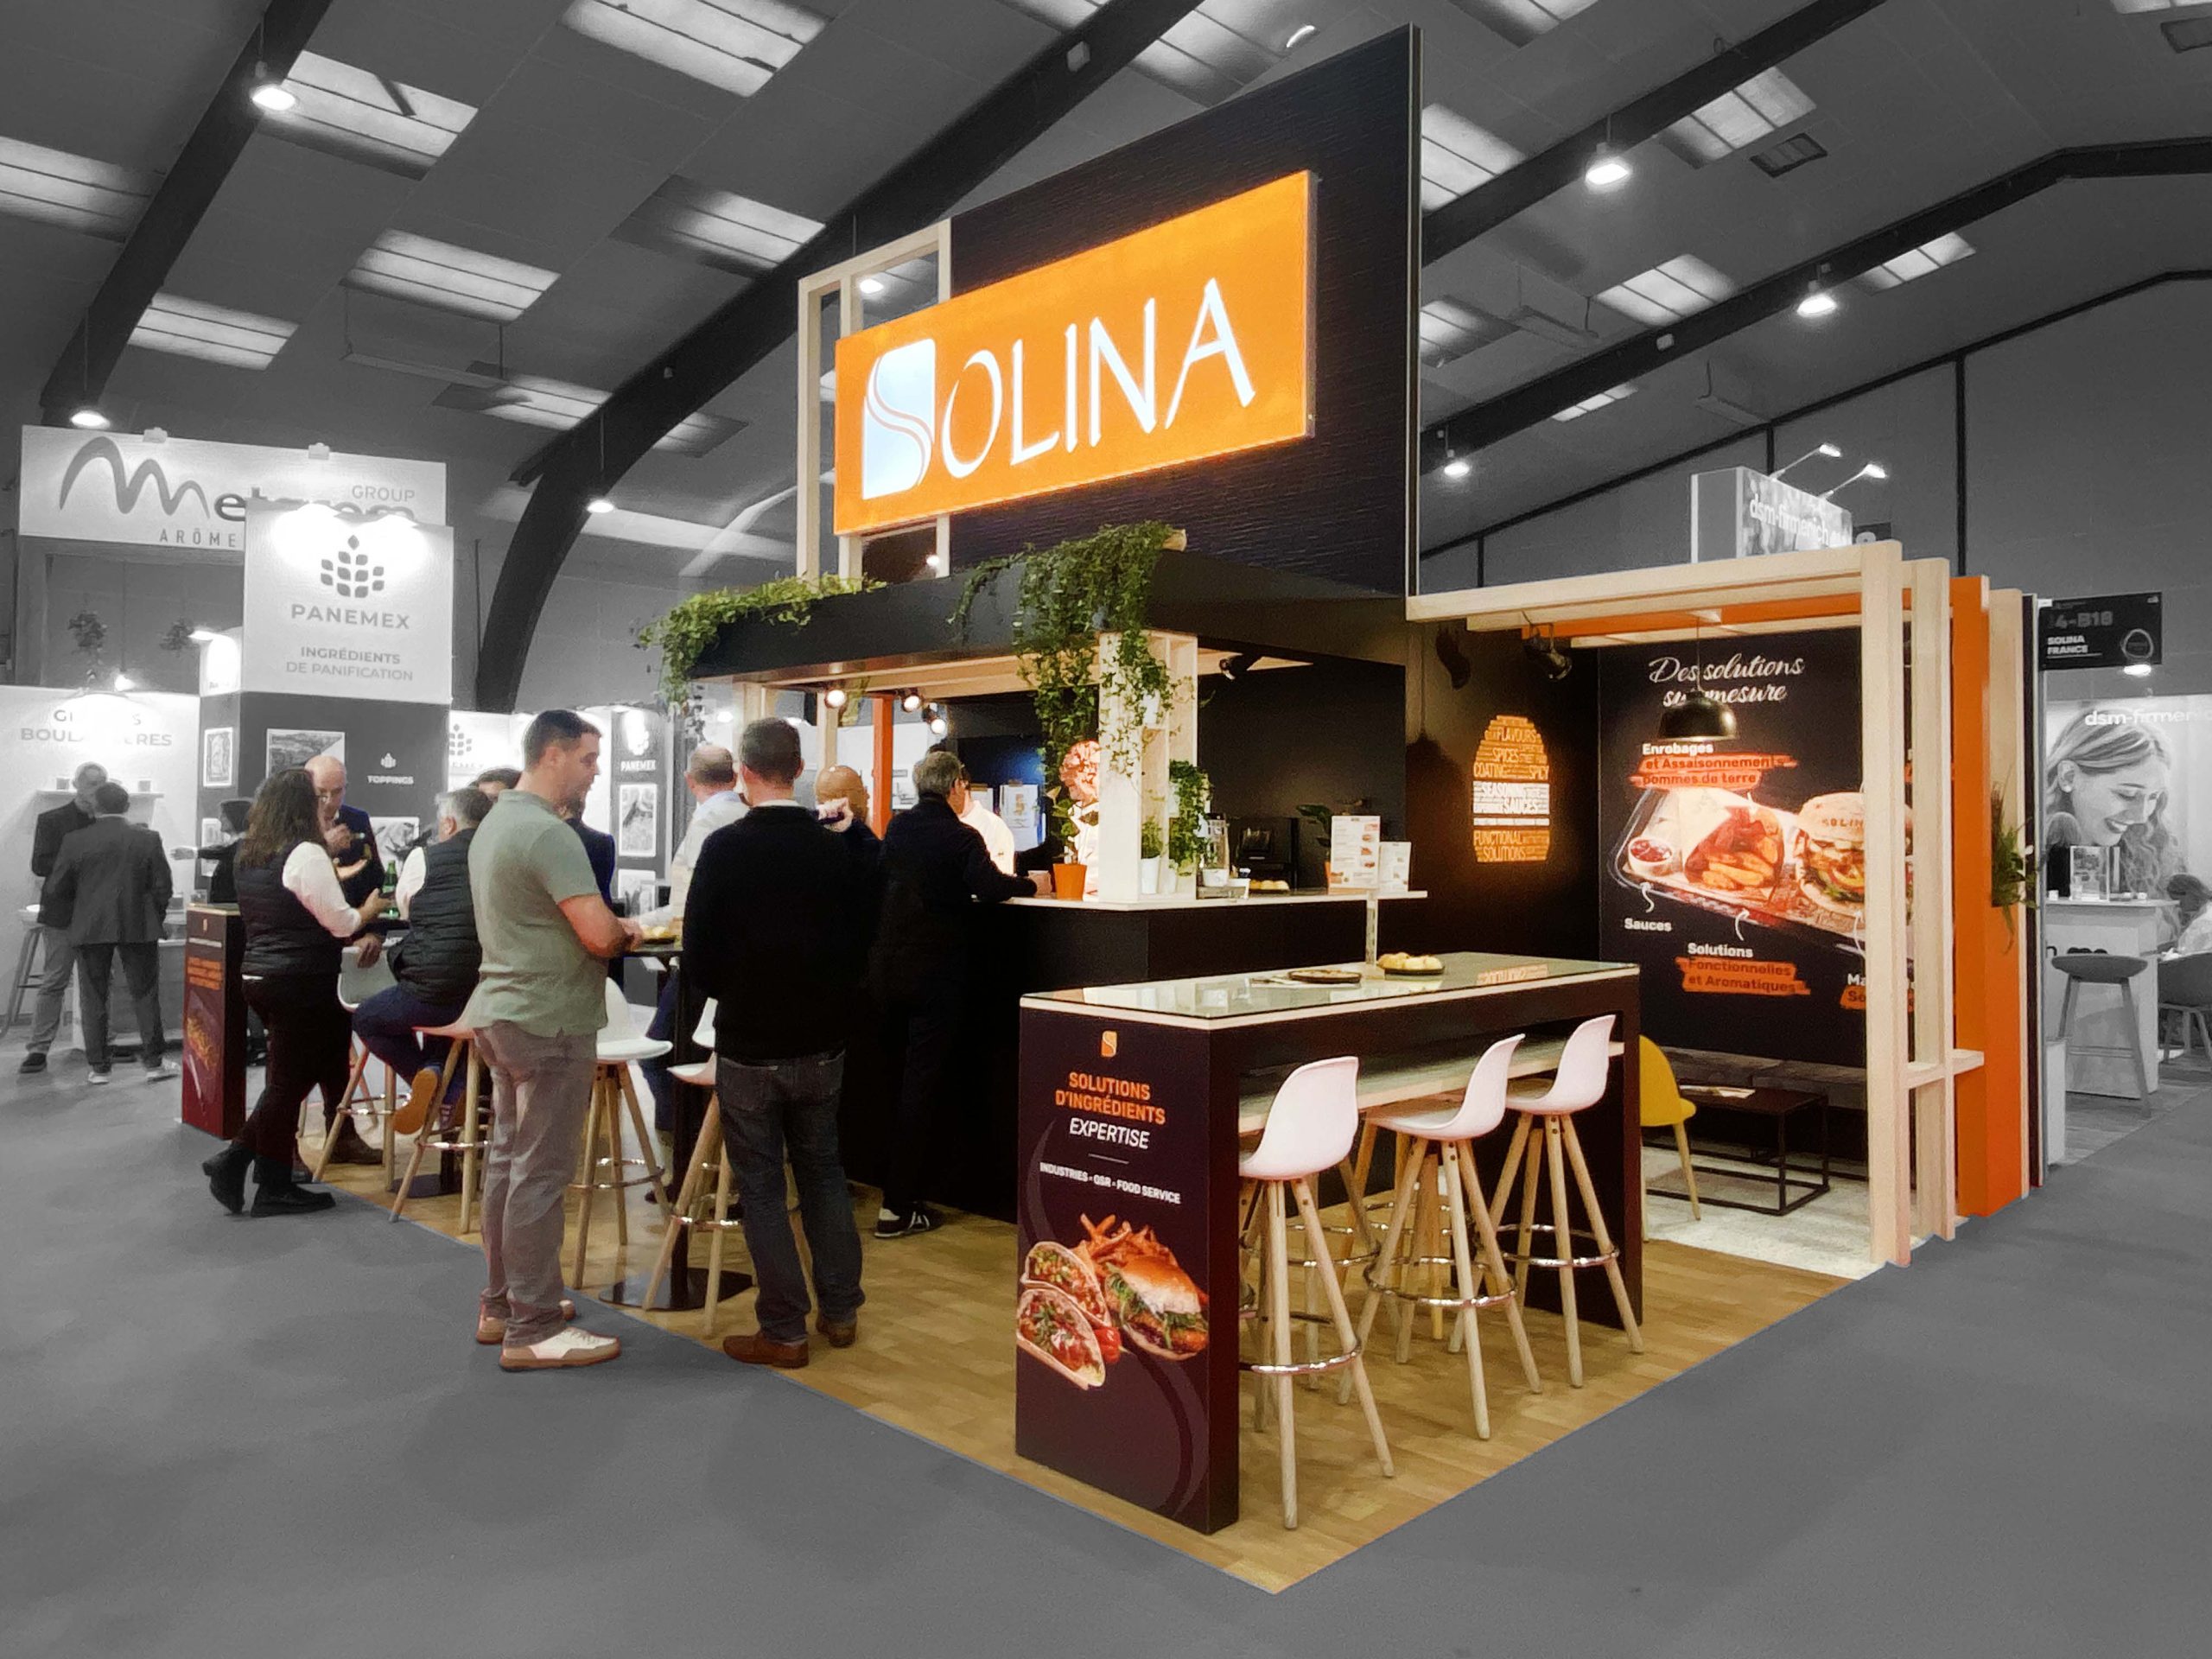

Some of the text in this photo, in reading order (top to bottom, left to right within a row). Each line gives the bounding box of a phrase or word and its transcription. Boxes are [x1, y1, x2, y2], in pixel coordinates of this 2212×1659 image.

[862, 277, 1255, 500] SOLINA
[352, 485, 415, 502] GROUP
[291, 604, 410, 630] PANEMEX
[301, 646, 401, 664] INGRÉDIENTS
[2047, 645, 2088, 655] FRANCE
[286, 662, 413, 682] DE PANIFICATION
[1649, 652, 1805, 683] Des solutions
[21, 728, 172, 746] BOULRES
[1643, 743, 1714, 756] Enrobages
[1646, 760, 1658, 769] et
[1643, 775, 1698, 785] pommes
[1722, 773, 1758, 784] terre
[1624, 918, 1672, 932] Sauces
[1688, 942, 1754, 958] Solutions
[1688, 958, 1791, 976] Fonctionnelles
[1688, 976, 1796, 993] et Aromatiques
[1069, 1071, 1151, 1101] SOLUTIONS
[1055, 1089, 1166, 1125] D'INGRÉDIENTS
[1069, 1117, 1150, 1149] EXPERTISE
[1039, 1161, 1088, 1182] INDUSTRIES
[1116, 1179, 1141, 1194] FOOD
[1141, 1185, 1181, 1204] SERVICE
